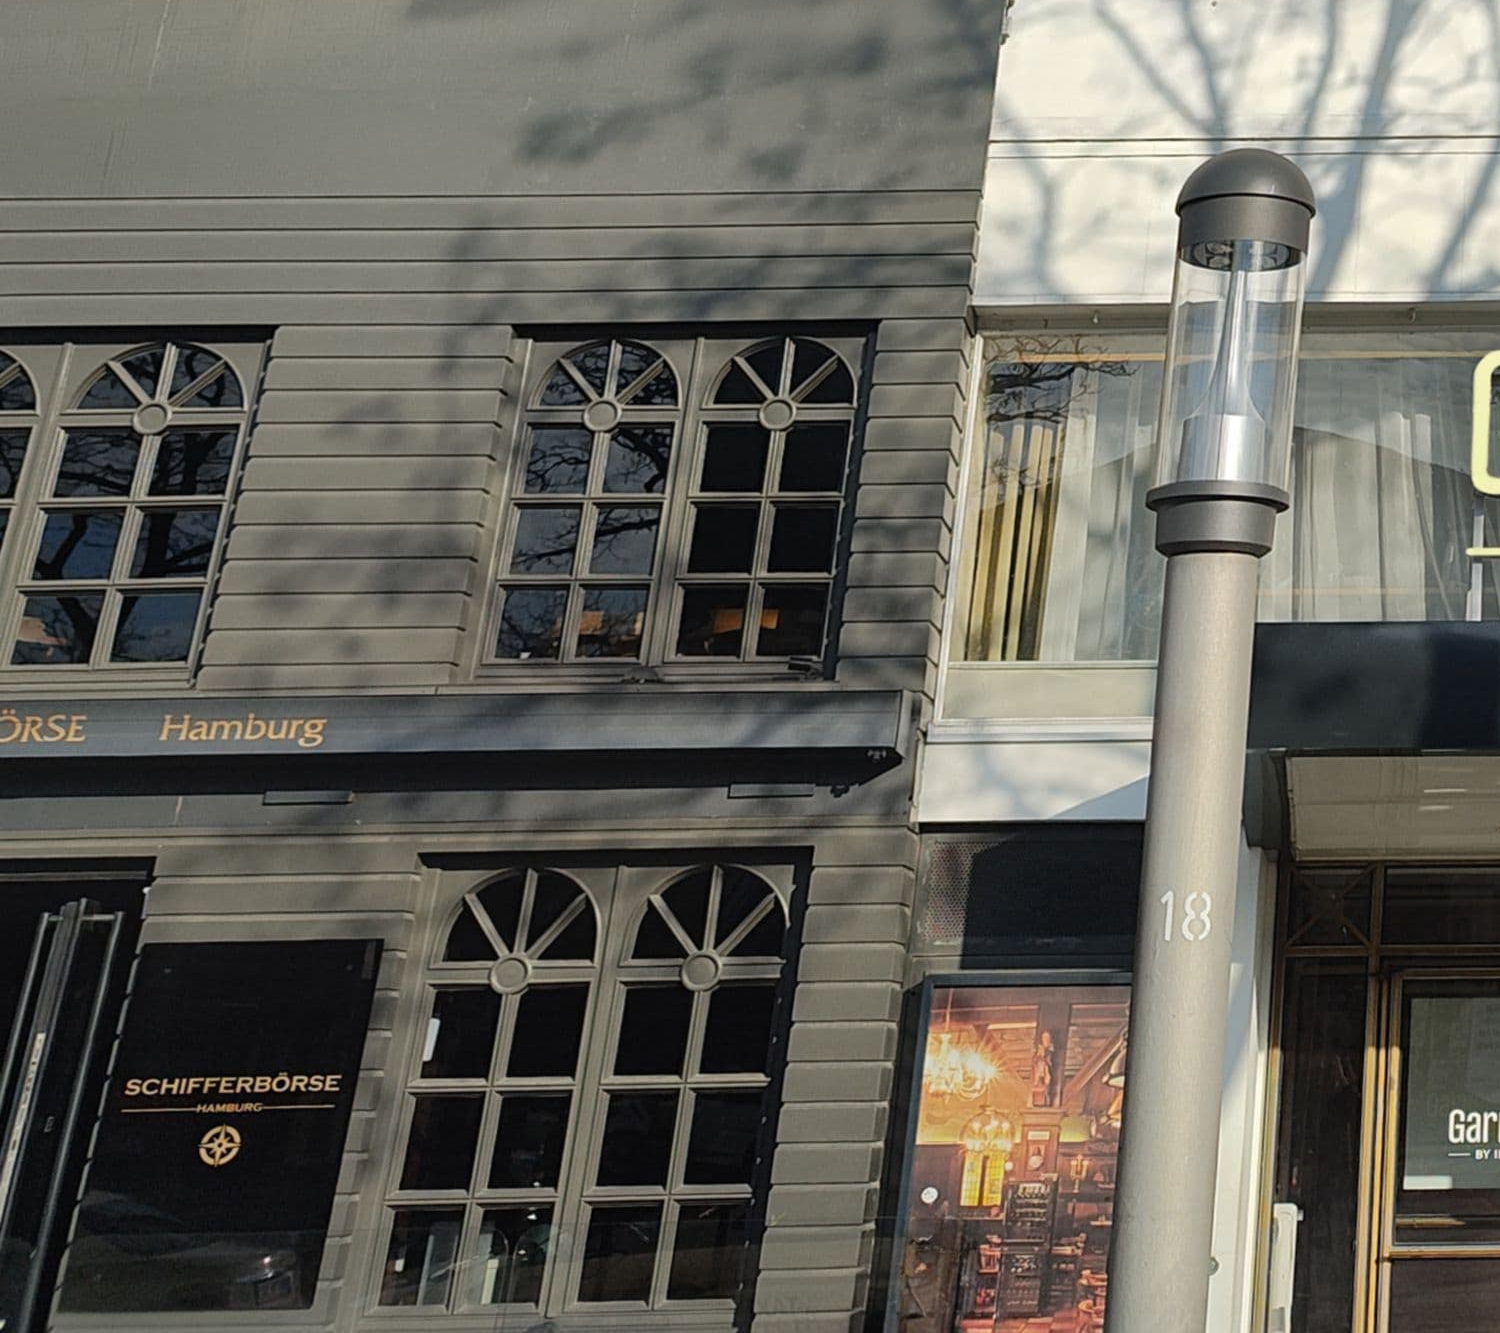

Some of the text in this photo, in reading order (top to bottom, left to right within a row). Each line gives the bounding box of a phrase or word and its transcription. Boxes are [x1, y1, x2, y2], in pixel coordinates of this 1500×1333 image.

[158, 712, 328, 749] Hamburg
[1160, 890, 1212, 942] 18
[124, 1072, 343, 1097] SCHIFFERBÖRSE
[196, 1102, 264, 1114] HAMBURG
[1475, 1149, 1490, 1160] BY
